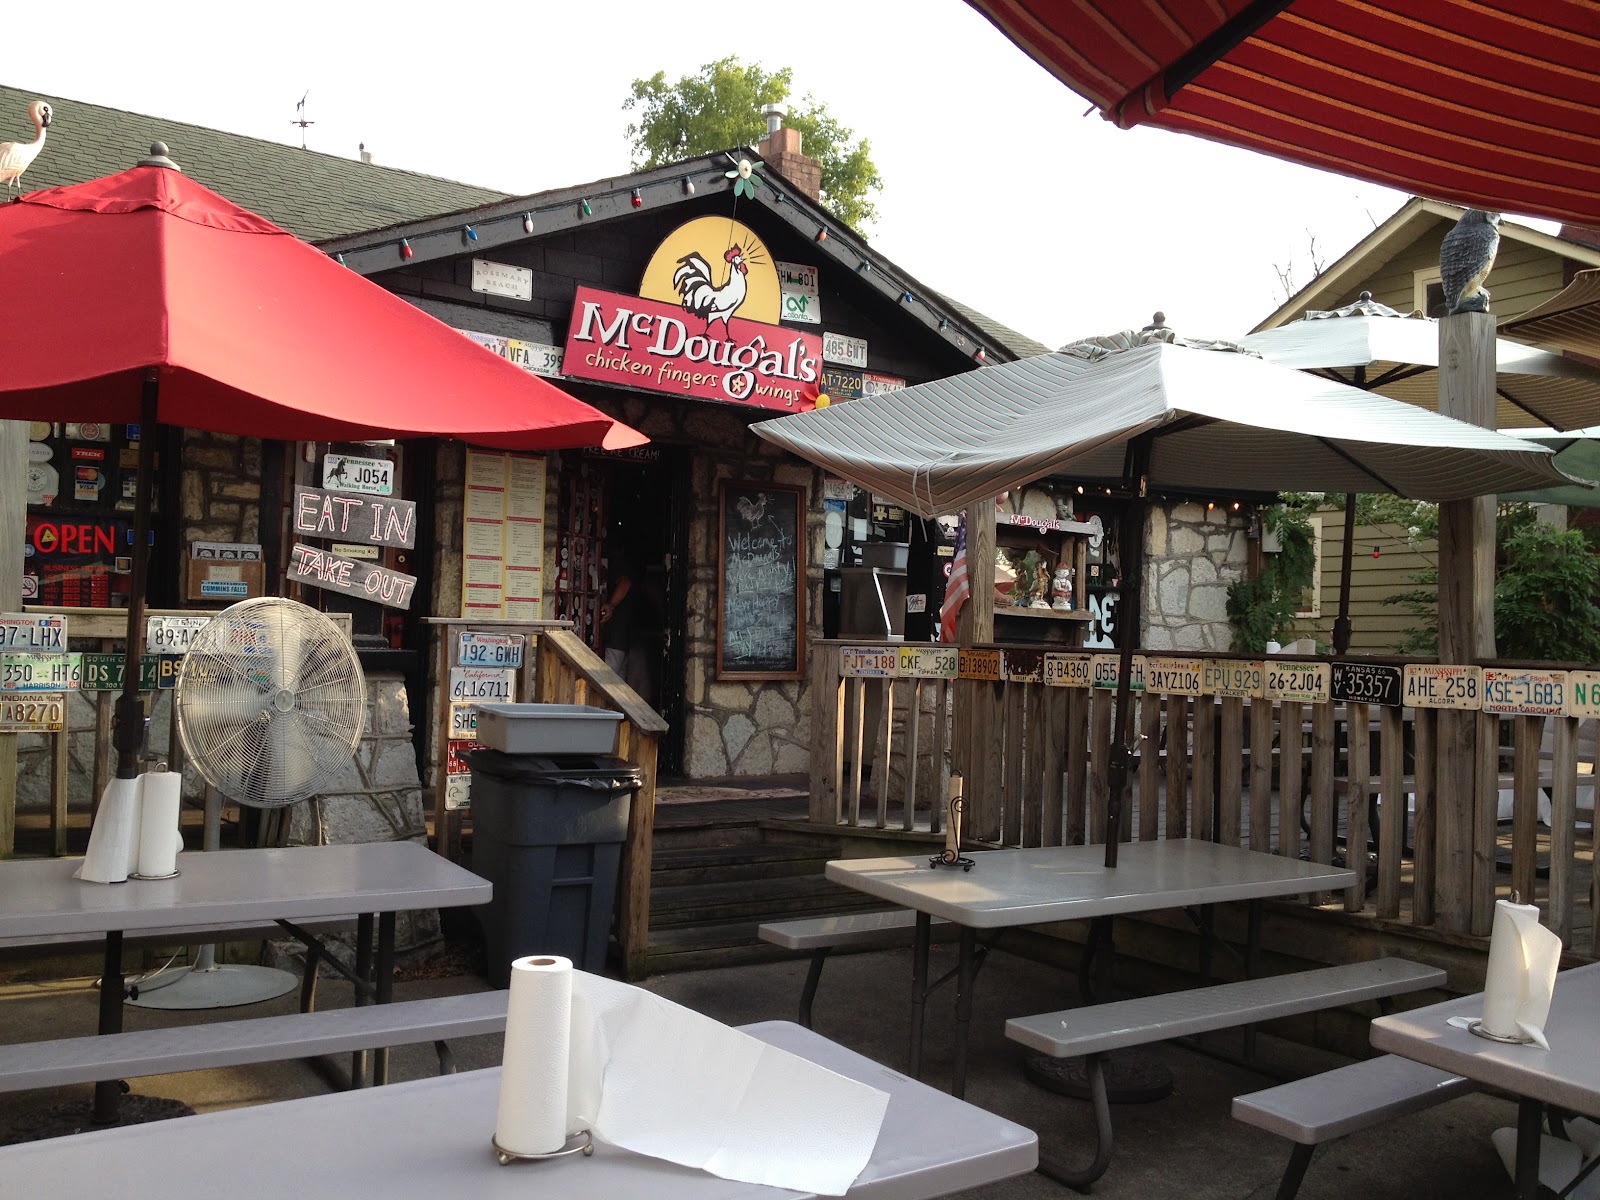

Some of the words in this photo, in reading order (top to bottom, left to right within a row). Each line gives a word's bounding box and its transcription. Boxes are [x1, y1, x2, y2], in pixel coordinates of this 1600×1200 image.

[475, 269, 529, 285] ROSEMARY
[486, 279, 518, 291] BEACH
[798, 272, 814, 287] 801
[573, 300, 817, 399] McDougal's
[825, 339, 844, 356] 485
[509, 346, 530, 365] VFA
[542, 352, 563, 368] 399
[585, 346, 653, 377] chicken
[656, 360, 719, 390] fingers
[754, 378, 802, 407] wings
[75, 450, 101, 458] TREK
[342, 457, 376, 467] Tennessee
[354, 467, 388, 486] J054
[339, 482, 361, 490] Walking
[297, 492, 364, 533] EAT
[369, 502, 414, 544] IN
[1010, 514, 1060, 535] McDougal's
[33, 523, 115, 554] OPEN
[727, 531, 778, 552] Welcome
[342, 547, 366, 555] Smoking
[292, 545, 355, 588] TAKE
[364, 569, 416, 604] OUT
[476, 636, 509, 645] Washington
[843, 655, 865, 669] FJT
[874, 655, 895, 669] 188
[935, 657, 956, 671] 528
[1279, 663, 1315, 671] Tennessee
[1345, 665, 1376, 674] KANSAS
[4, 664, 33, 682] 350
[88, 664, 109, 682] DS
[464, 670, 500, 680] California
[1095, 662, 1117, 681] 055
[1150, 670, 1199, 690] 3AYZ106
[1234, 670, 1260, 690] 929
[1424, 667, 1462, 679] MISSISSIPPI
[454, 680, 510, 698] 6L16711
[1408, 676, 1438, 697] AHE
[1446, 677, 1477, 699] 258
[1485, 681, 1563, 706] KSE-1683
[1489, 704, 1518, 713] NORTH
[1520, 706, 1562, 715] CAROLINA
